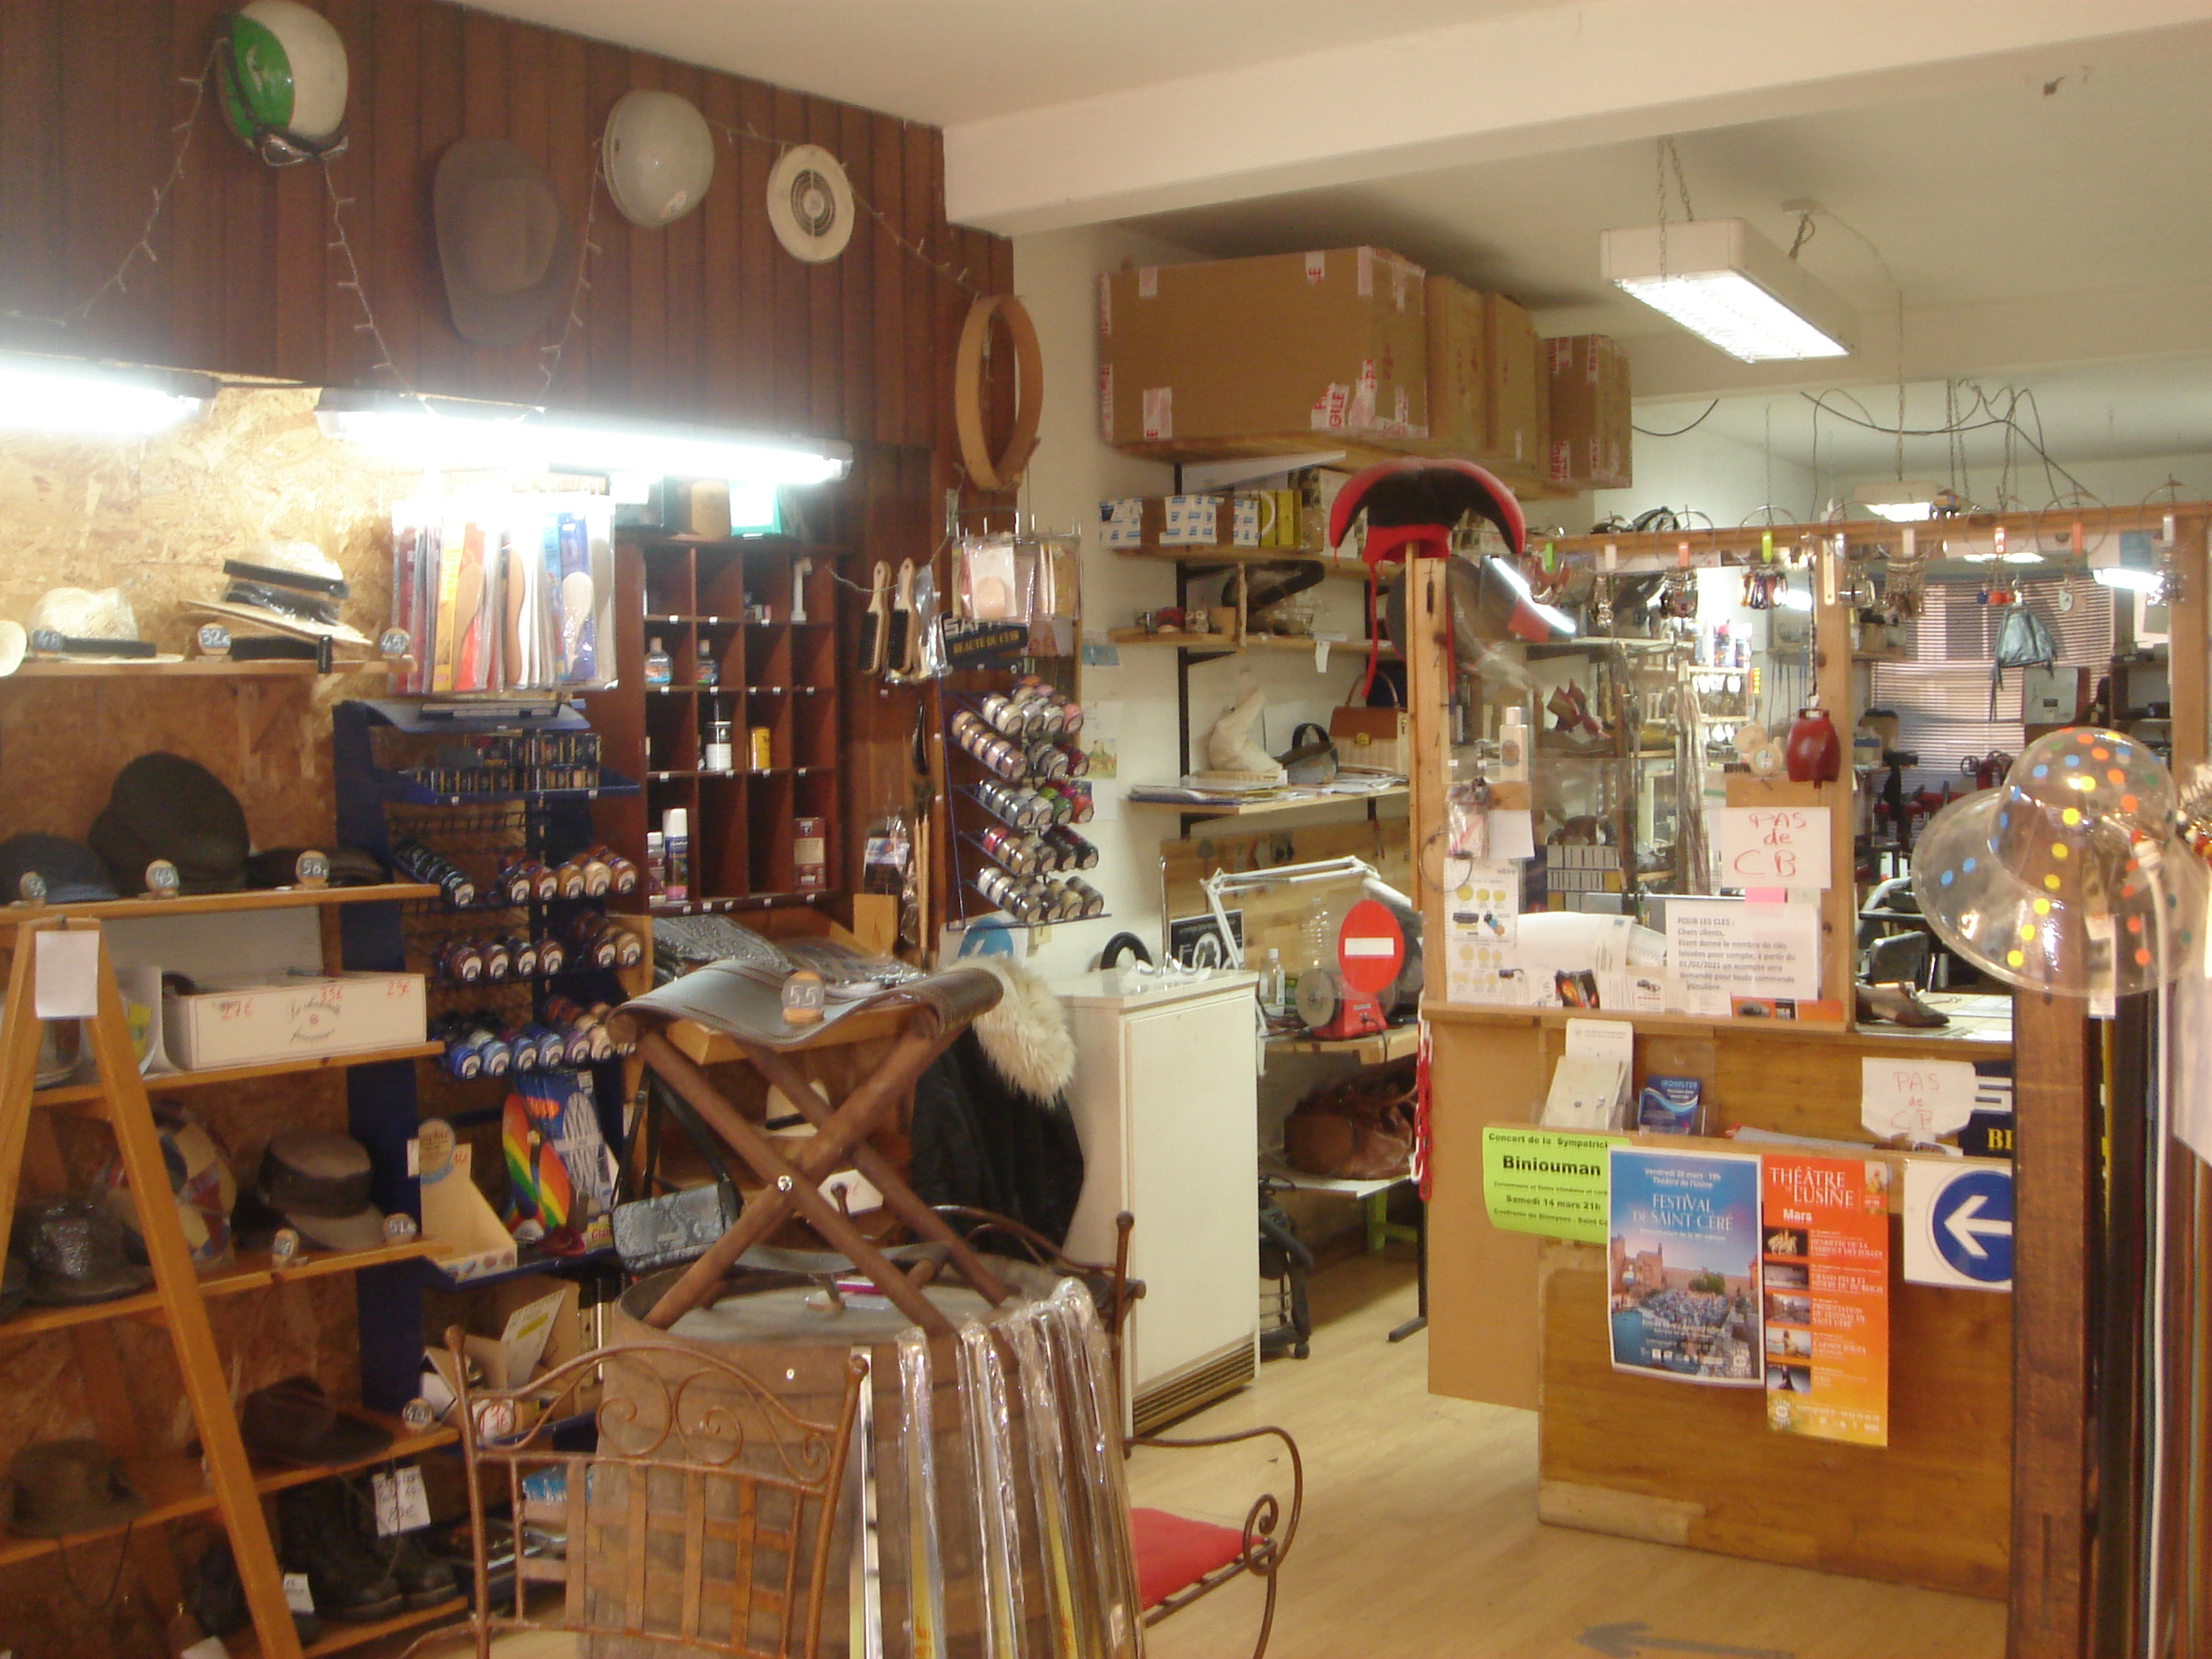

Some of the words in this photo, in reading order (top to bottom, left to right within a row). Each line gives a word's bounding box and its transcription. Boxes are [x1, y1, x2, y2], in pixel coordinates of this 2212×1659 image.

[1748, 812, 1807, 830] PAS
[1763, 827, 1793, 846] de
[1677, 917, 1699, 926] POUR
[1700, 917, 1713, 926] LES
[1732, 940, 1761, 949] nombre
[1763, 952, 1784, 961] partir
[1892, 1072, 1940, 1091] PAS
[1907, 1095, 1923, 1107] de
[1488, 1132, 1525, 1144] Concert
[1528, 1135, 1540, 1144] de
[1542, 1136, 1551, 1145] la
[1502, 1155, 1601, 1176] Biniouman
[1769, 1166, 1846, 1190] THÉÂTRE
[1505, 1195, 1540, 1206] Samedi
[1543, 1196, 1554, 1208] 14
[1557, 1201, 1580, 1210] mars
[1583, 1202, 1601, 1211] 21h
[1653, 1193, 1711, 1213] FESTIVAL
[1783, 1208, 1813, 1223] Mars
